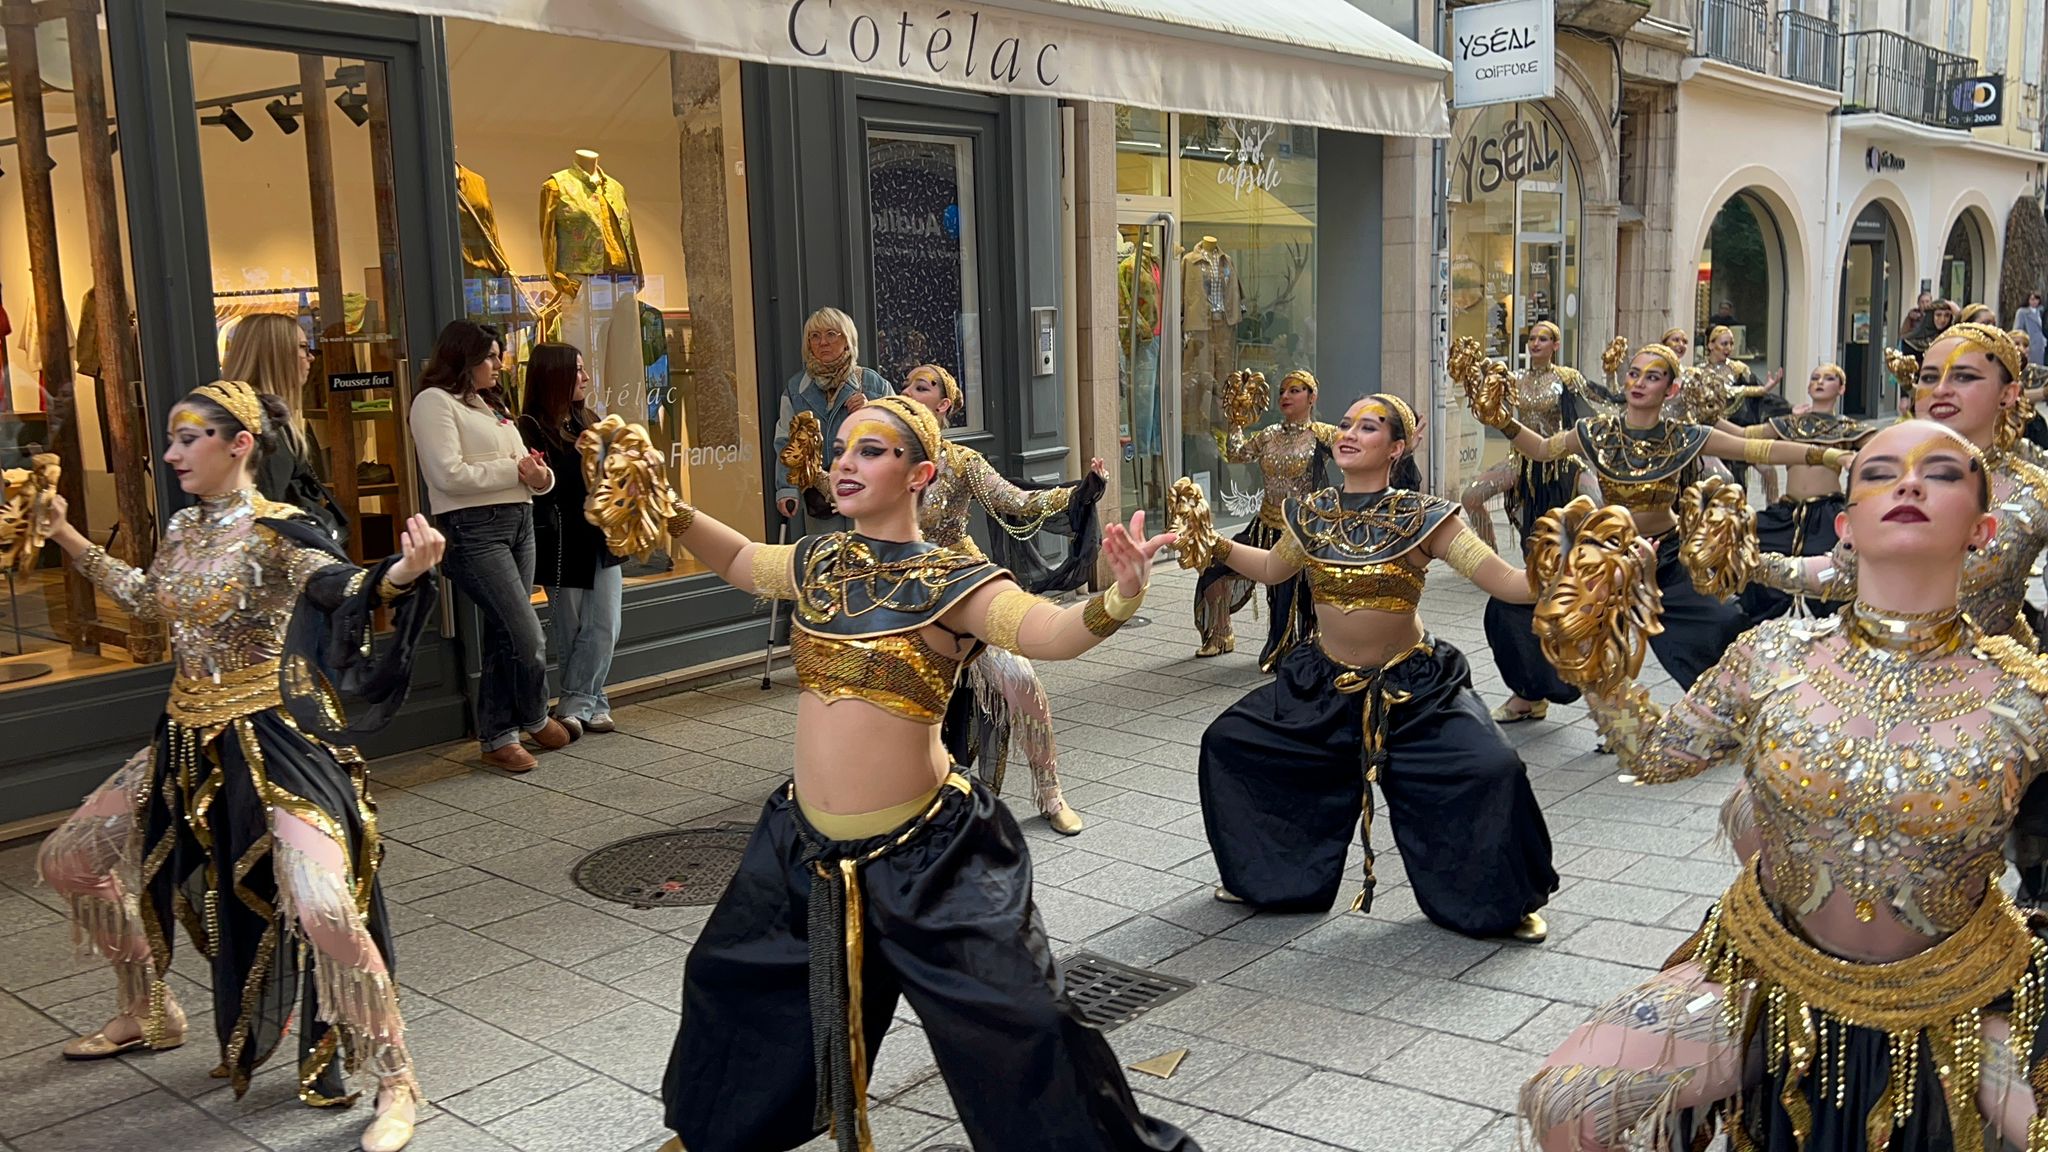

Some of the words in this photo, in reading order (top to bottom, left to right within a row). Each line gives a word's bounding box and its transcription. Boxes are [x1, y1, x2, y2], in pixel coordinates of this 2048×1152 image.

[788, 0, 1059, 87] Cotélac
[1459, 27, 1536, 61] YSÉAL
[1974, 113, 1997, 123] 2000
[1459, 120, 1559, 204] YSÉAL
[1217, 158, 1282, 201] capsule
[333, 377, 370, 388] Poussez
[372, 375, 389, 385] fort
[585, 383, 677, 409] otélac
[670, 438, 752, 470] Français
